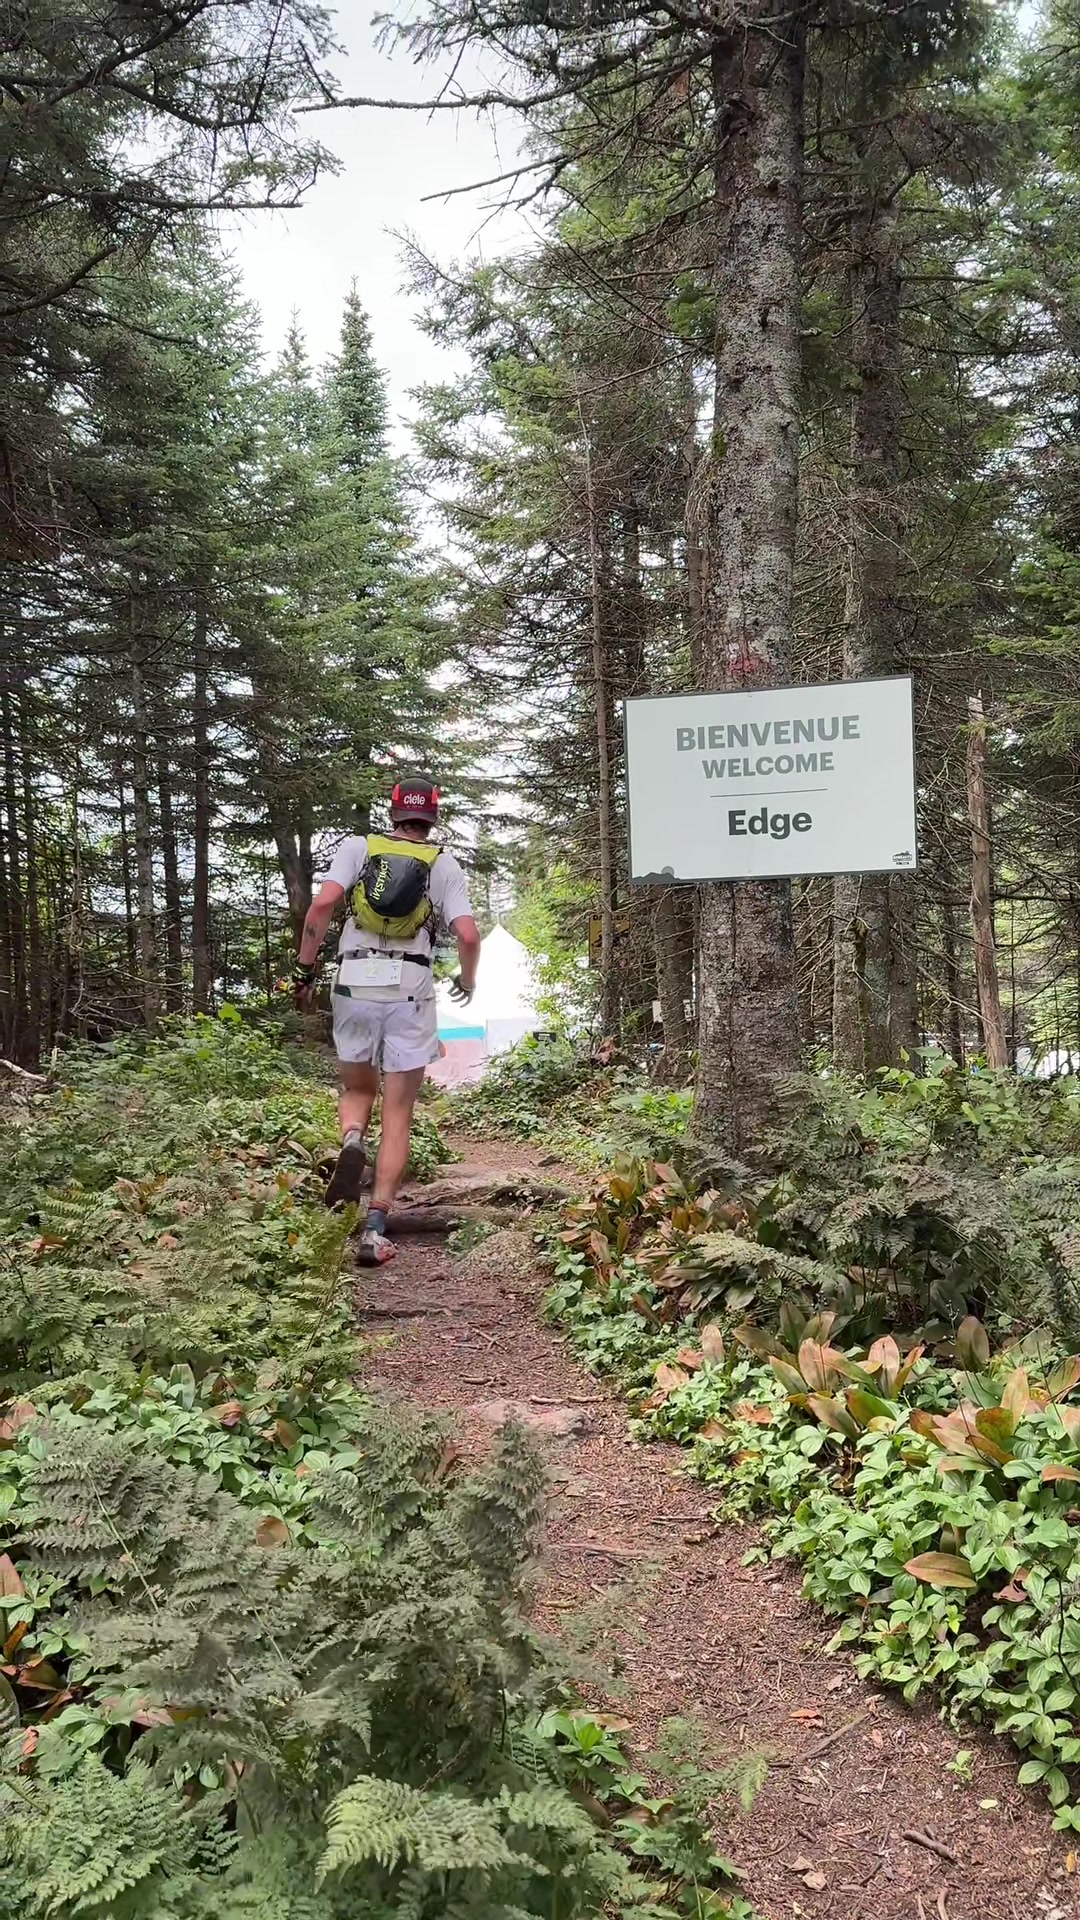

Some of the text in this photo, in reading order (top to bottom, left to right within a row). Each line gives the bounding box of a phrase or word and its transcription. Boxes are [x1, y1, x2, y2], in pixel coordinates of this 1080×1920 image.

[676, 715, 860, 751] BIENVENUE
[702, 752, 834, 779] WELCOME
[403, 793, 426, 805] ciele
[728, 807, 812, 840] Edge
